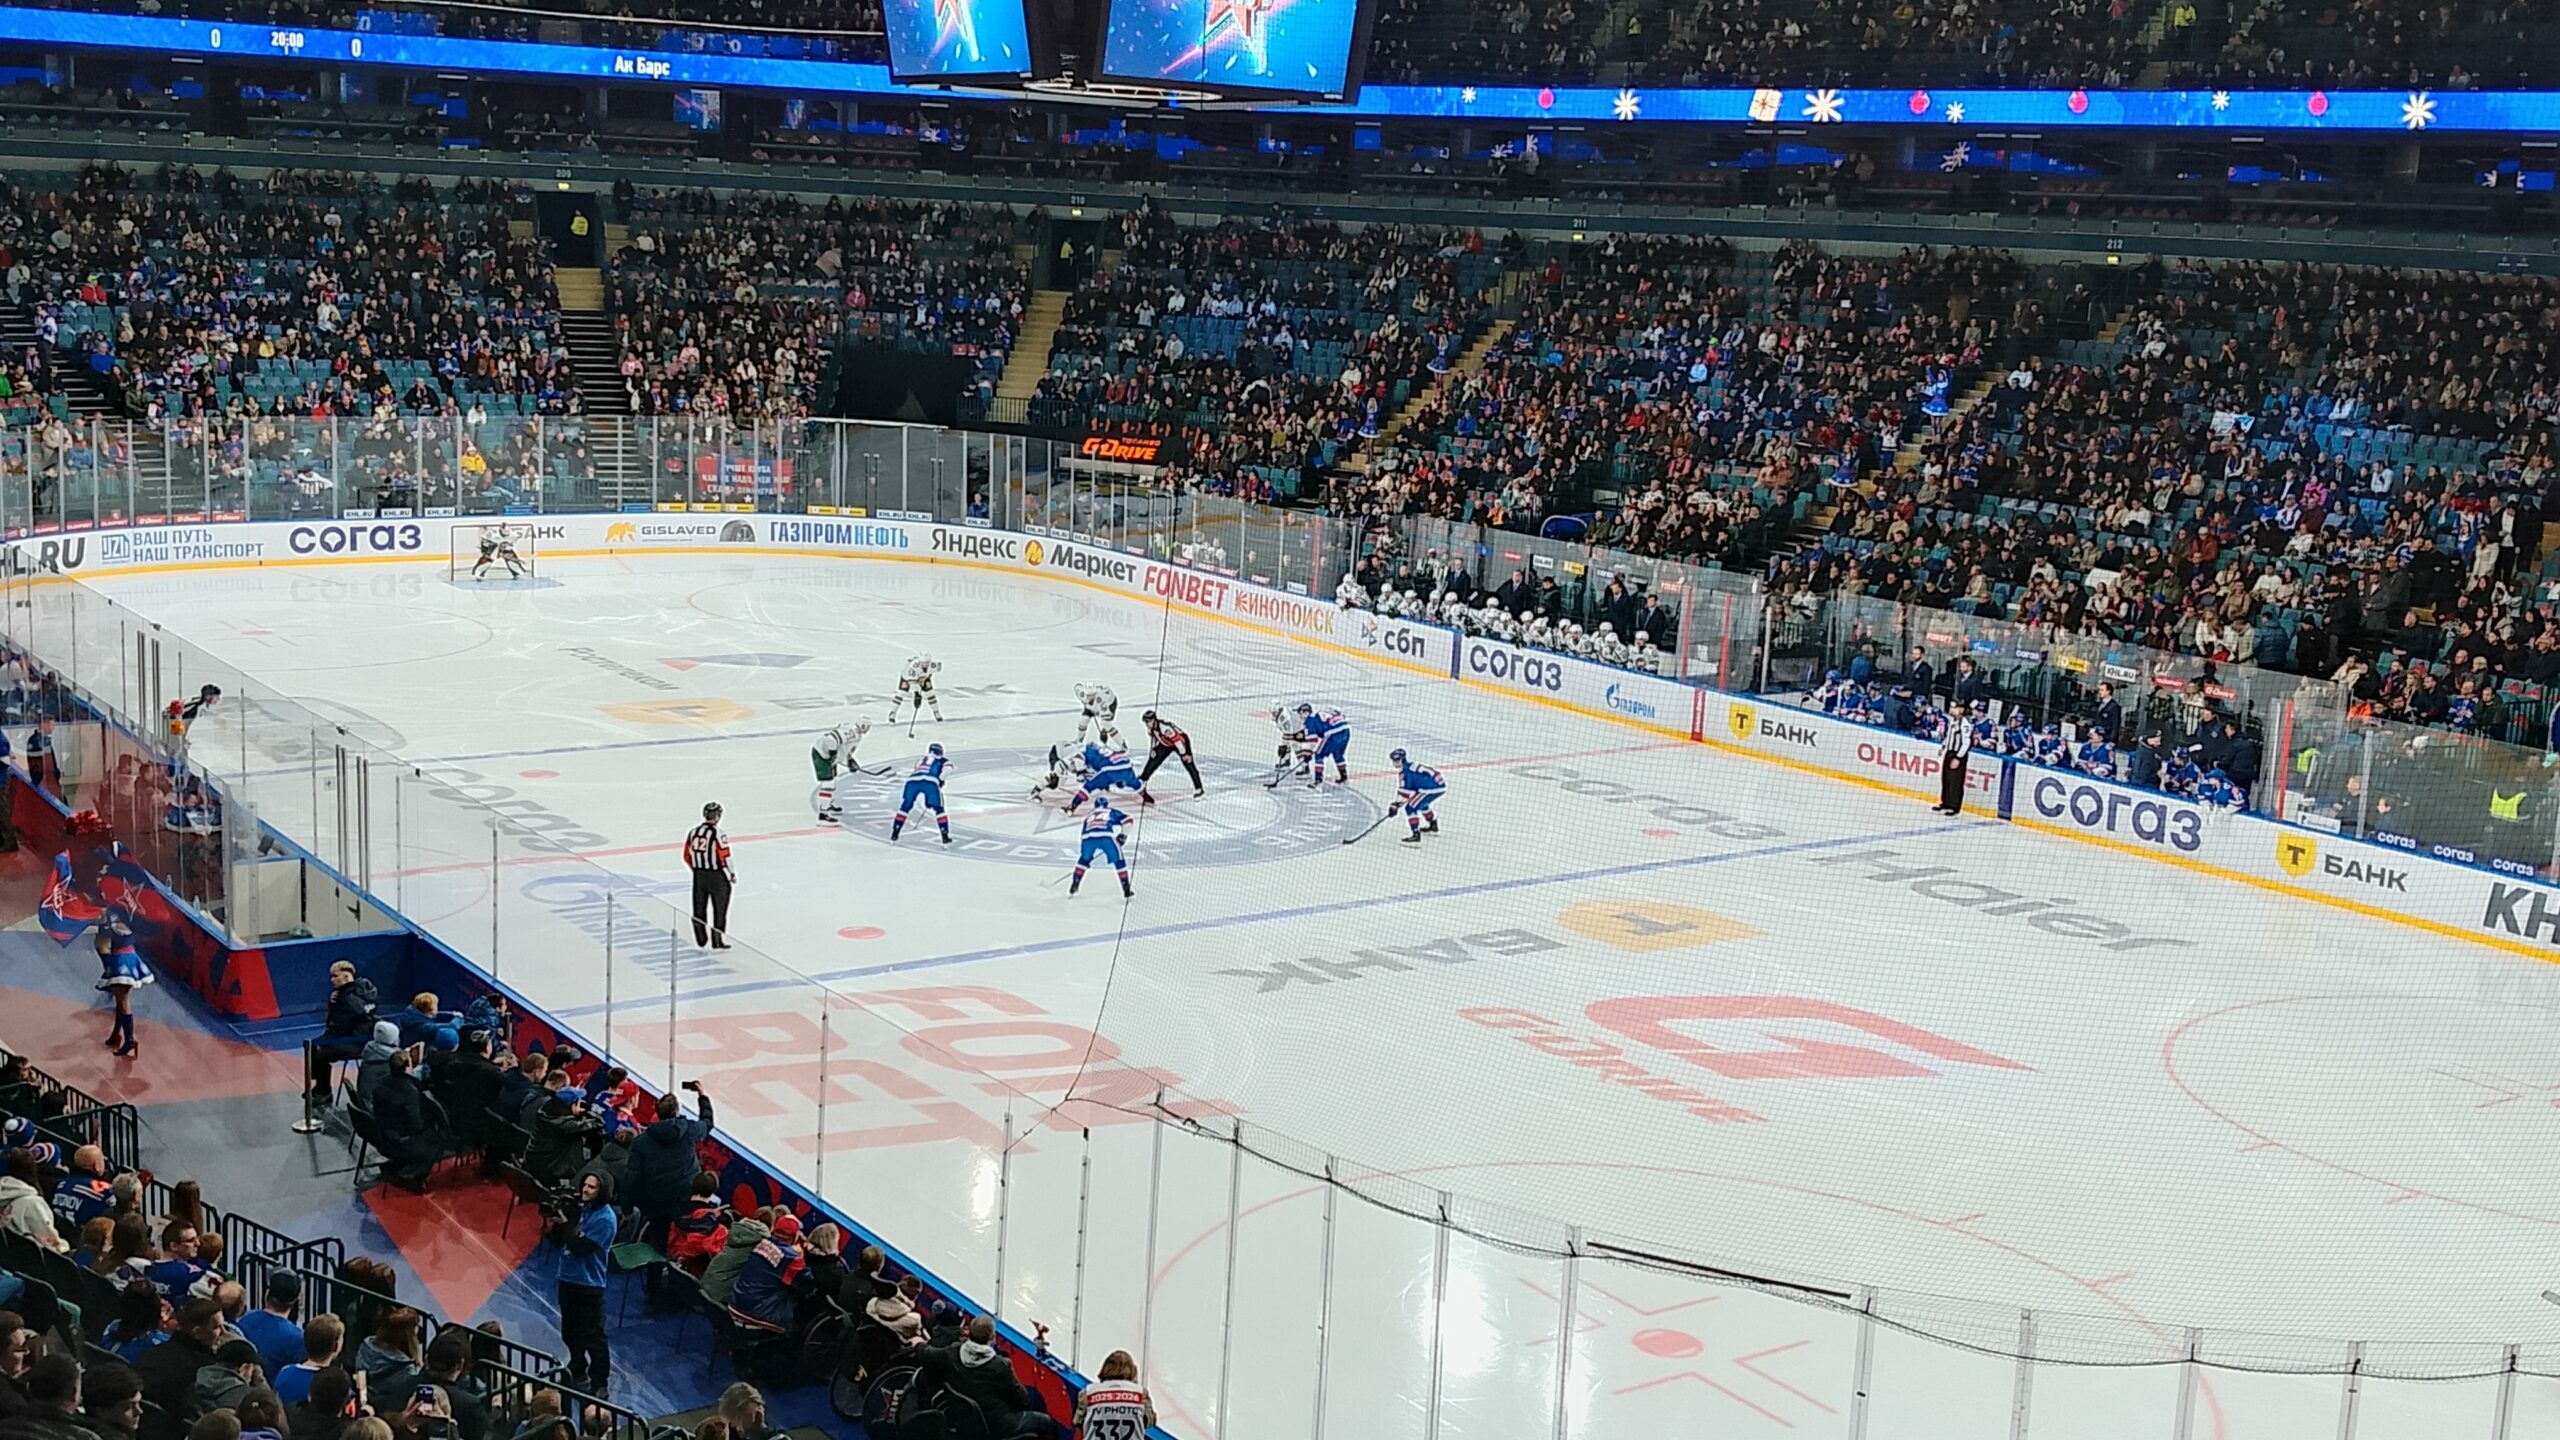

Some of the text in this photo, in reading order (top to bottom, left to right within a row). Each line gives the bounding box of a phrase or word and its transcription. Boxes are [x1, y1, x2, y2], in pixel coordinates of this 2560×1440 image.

[210, 28, 221, 48] 0
[271, 31, 304, 48] 20:00
[351, 38, 362, 58] 0
[615, 55, 670, 79] Ак Барс
[556, 169, 572, 178] 209
[1070, 195, 1086, 205] 210
[1573, 218, 1587, 228] 211
[2107, 239, 2123, 249] 212
[134, 529, 212, 546] ВАШ ПУТЬ
[289, 524, 422, 553] согаз
[641, 526, 717, 535] GISLAVED
[770, 521, 909, 549] ГАЗПРОМНЕФТЬ
[134, 547, 168, 562] НАШ
[173, 543, 263, 560] ТРАНСПОРТ
[932, 528, 1017, 559] Яндекс
[1050, 543, 1137, 583] Маркет
[1143, 566, 1229, 610] FONBET
[1384, 627, 1425, 658] сбп
[1469, 643, 1563, 692] согаз
[2107, 667, 2134, 679] KHL.RU
[1760, 718, 1818, 748] БАНК
[1857, 742, 1996, 793] OLIMPET
[2033, 776, 2201, 851] согаз
[693, 836, 707, 850] 42
[2377, 830, 2416, 850] согаз
[2434, 843, 2475, 863] согаз
[2323, 853, 2408, 893] БАНК
[2492, 856, 2534, 877] согаз
[1806, 850, 2202, 953] Haier
[1212, 926, 1571, 995] БАНК
[815, 984, 1245, 1132] FON
[614, 1011, 1041, 1156] BET
[1093, 1419, 1136, 1440] 332
